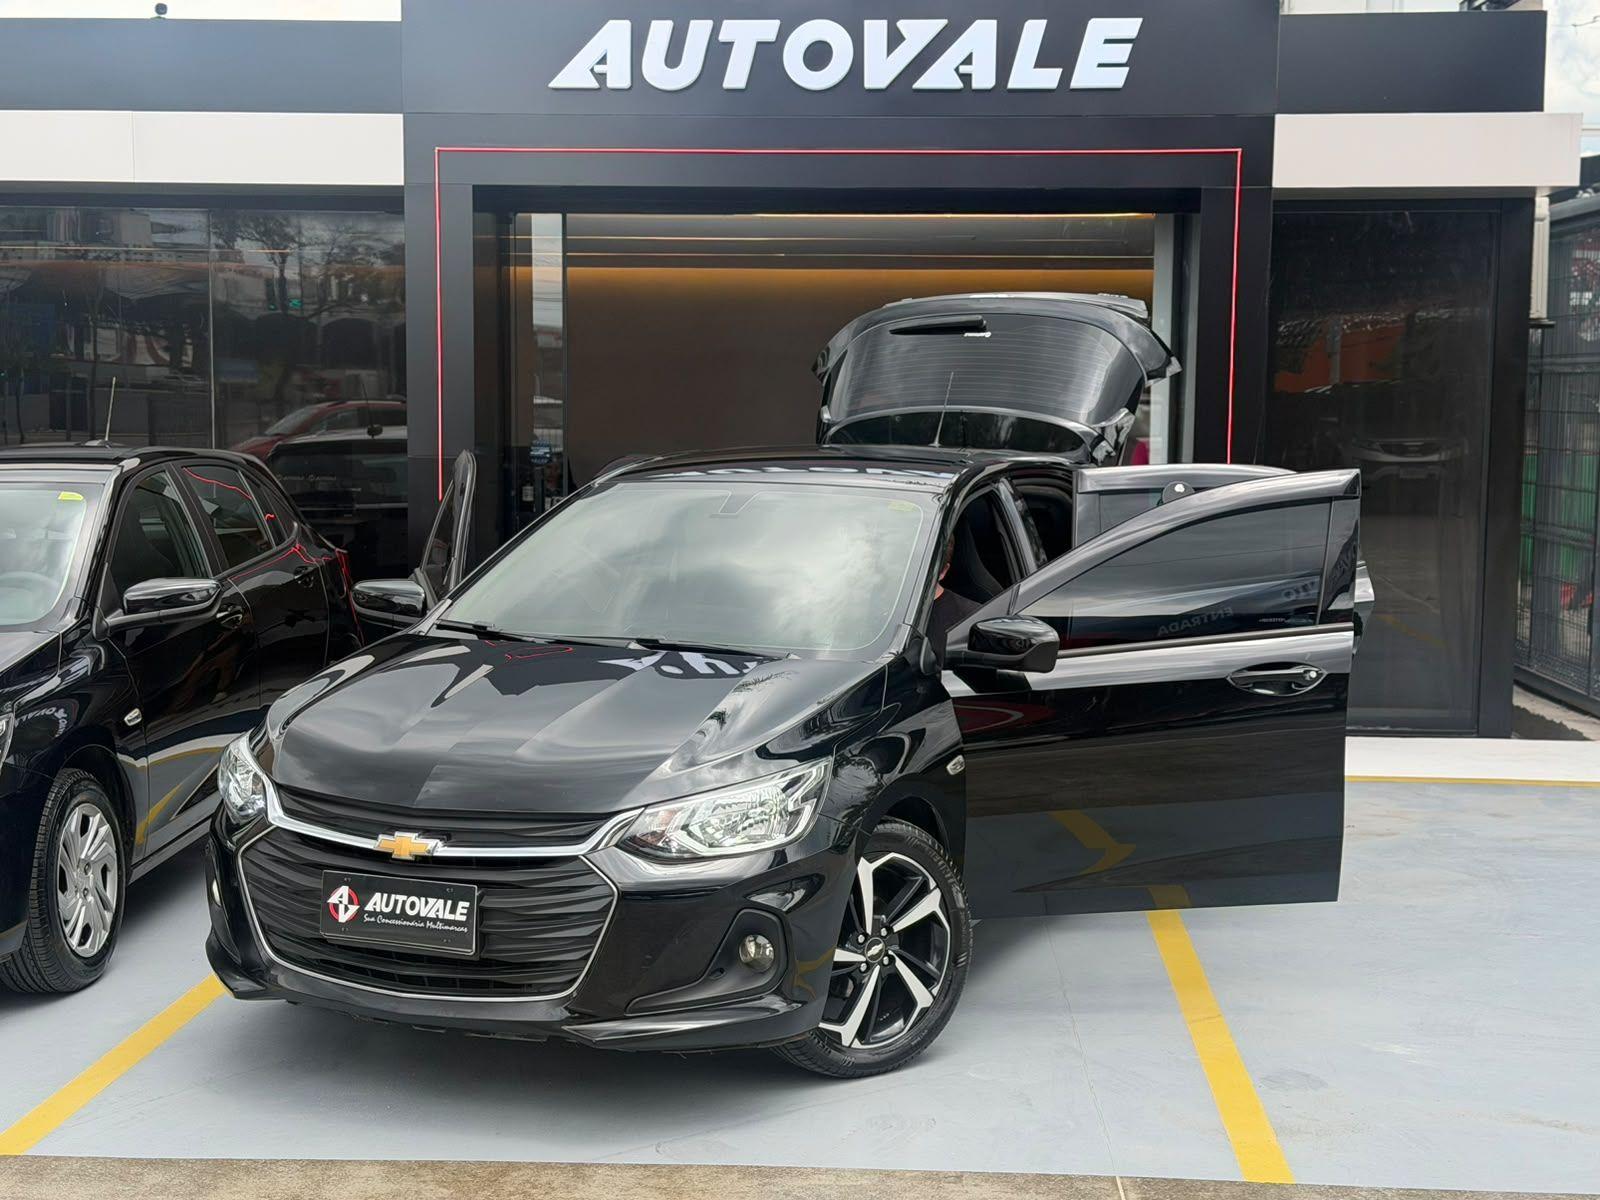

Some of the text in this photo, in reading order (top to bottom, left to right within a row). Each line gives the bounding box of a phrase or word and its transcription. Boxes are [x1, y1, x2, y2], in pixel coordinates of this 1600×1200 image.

[549, 18, 1143, 90] AUTOVALE
[364, 892, 470, 921] AUTOVALE
[363, 913, 376, 923] Sua
[425, 920, 468, 933] Multimarcas
